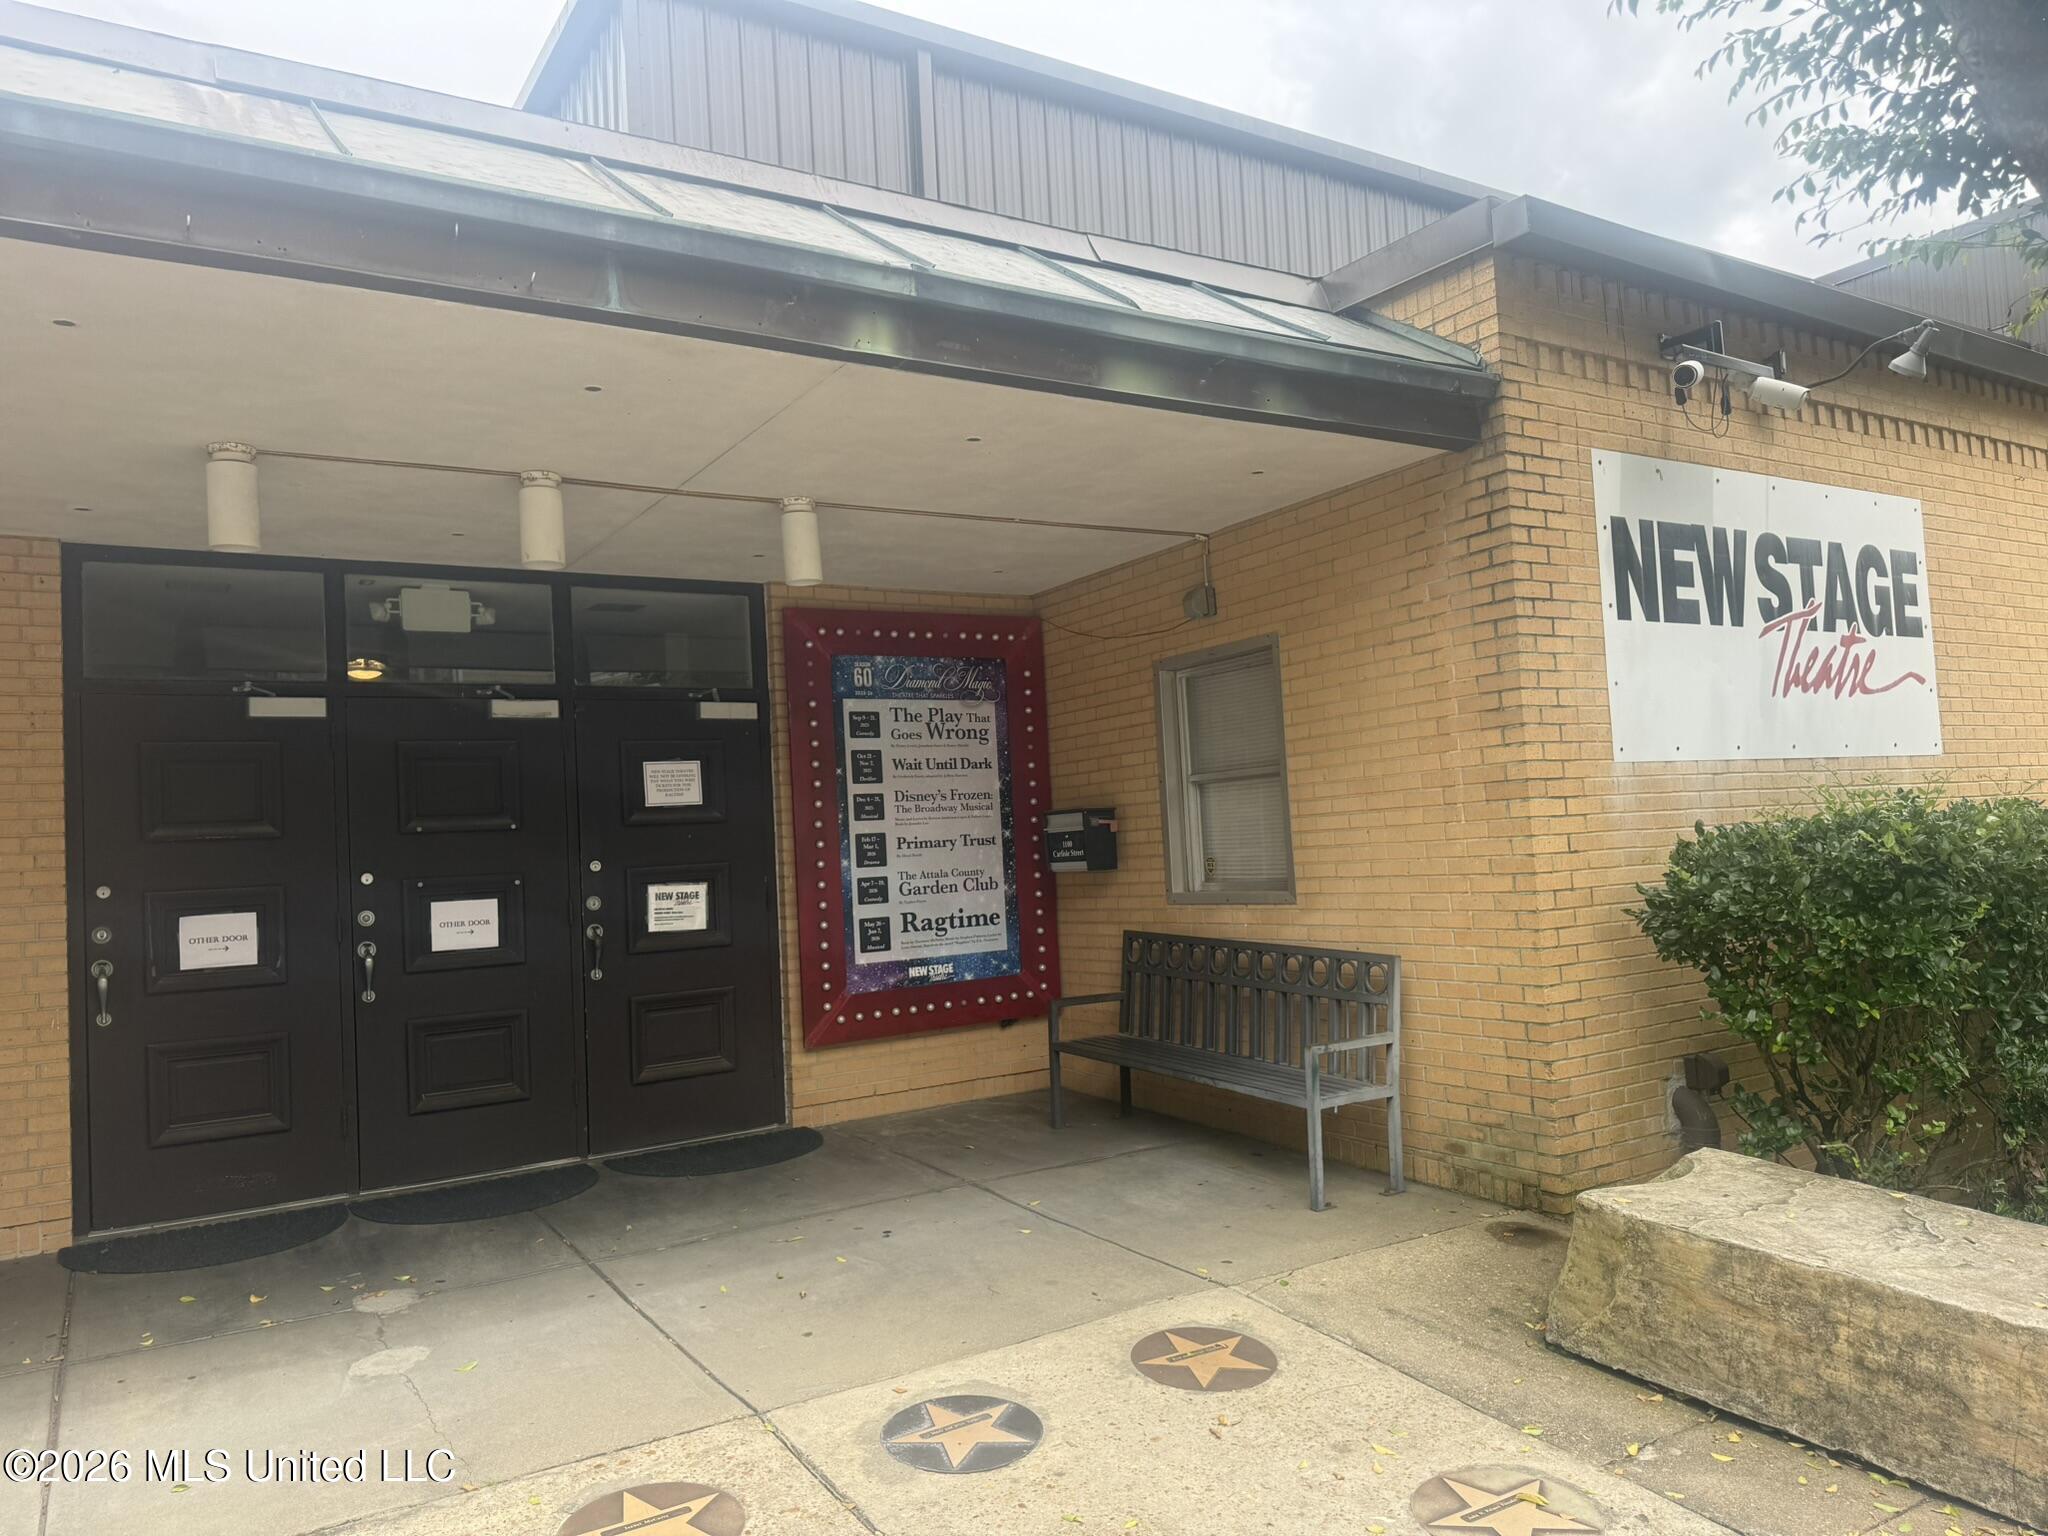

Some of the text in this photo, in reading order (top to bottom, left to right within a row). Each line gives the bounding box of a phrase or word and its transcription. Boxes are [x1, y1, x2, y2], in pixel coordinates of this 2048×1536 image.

[1610, 515, 1925, 638] NEW STAGE
[1758, 598, 1927, 701] Theatre
[853, 667, 873, 688] 60
[880, 664, 943, 690] Diamond
[889, 707, 991, 727] The Play That
[890, 722, 990, 745] Goes Wrong
[892, 757, 993, 770] Wait Until Dark
[894, 788, 994, 806] Disney's Frozen:
[894, 802, 994, 814] The Broadway Musical
[896, 834, 997, 851] Primary Trust
[1070, 849, 1085, 857] Street
[897, 868, 985, 881] The Attala County
[899, 876, 999, 897] Garden Club
[655, 890, 700, 901] NEW STAGE
[439, 918, 492, 928] OTHER DOOR
[900, 908, 1001, 937] Ragtime
[188, 934, 249, 945] OTHER DOOR
[908, 963, 954, 978] NEW STAGE
